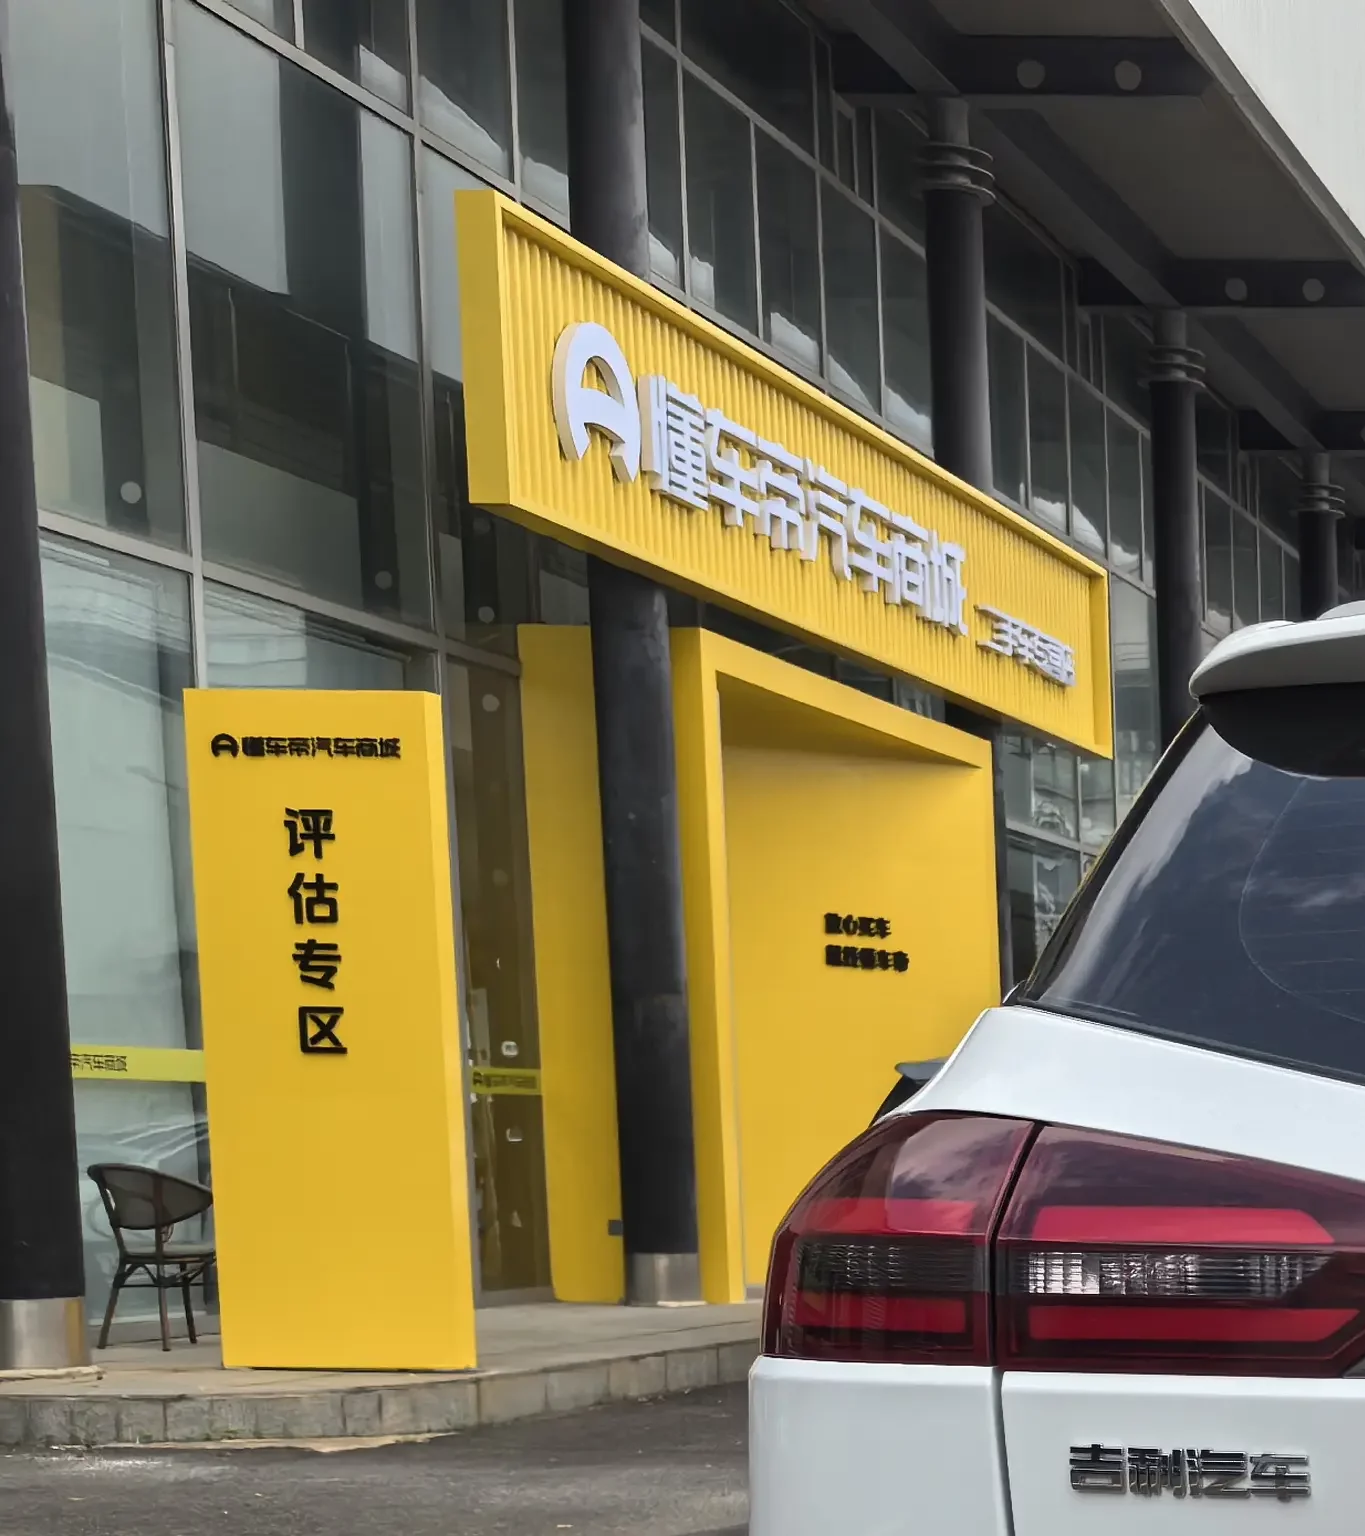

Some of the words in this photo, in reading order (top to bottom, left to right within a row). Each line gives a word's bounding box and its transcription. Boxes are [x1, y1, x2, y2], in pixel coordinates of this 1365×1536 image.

[640, 374, 968, 637] 懂车帝汽车商城
[284, 807, 348, 1055] 评估专区
[1069, 1443, 1312, 1502] 吉利汽车
